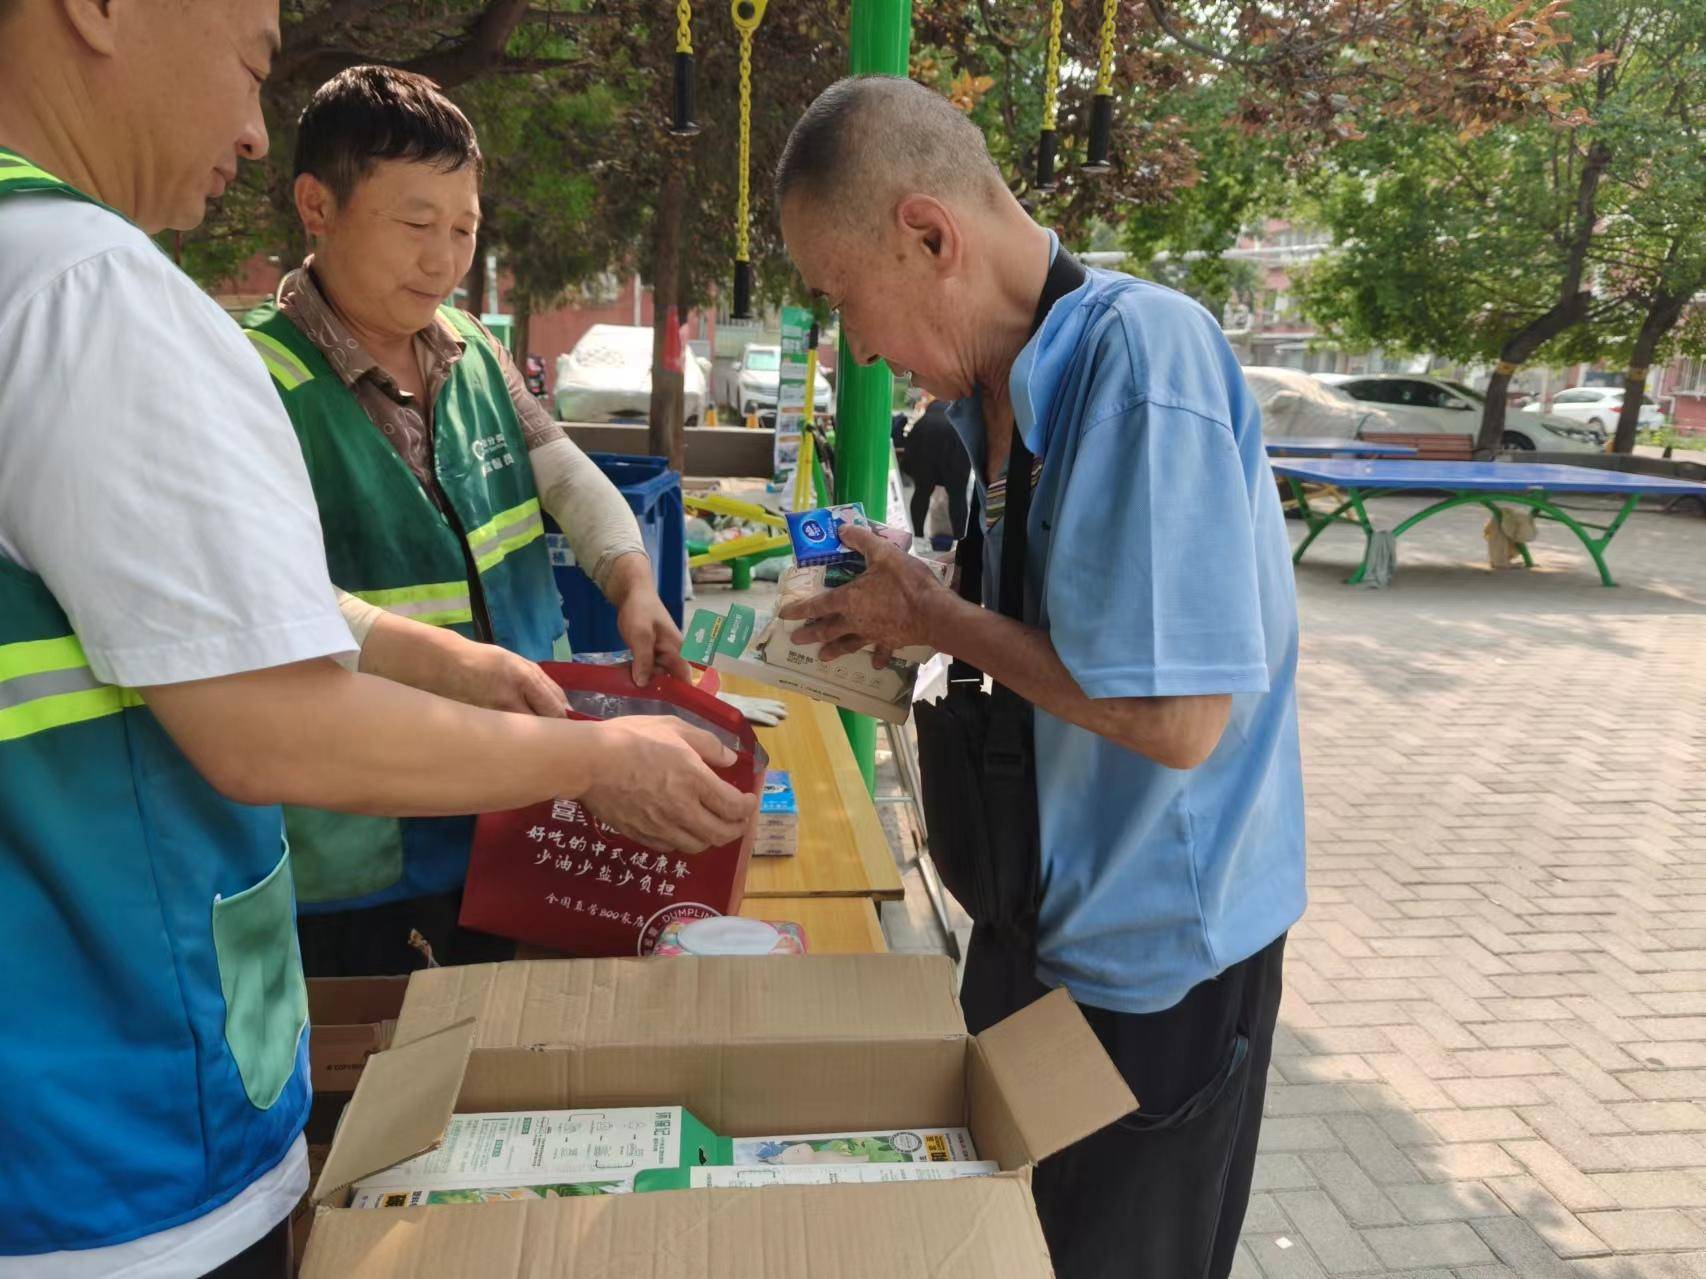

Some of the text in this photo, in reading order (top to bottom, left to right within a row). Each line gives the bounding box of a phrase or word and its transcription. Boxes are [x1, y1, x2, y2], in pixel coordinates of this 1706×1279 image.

[525, 825, 692, 878] 好吃的中式健康餐
[533, 849, 676, 896] 少油少盐少负担
